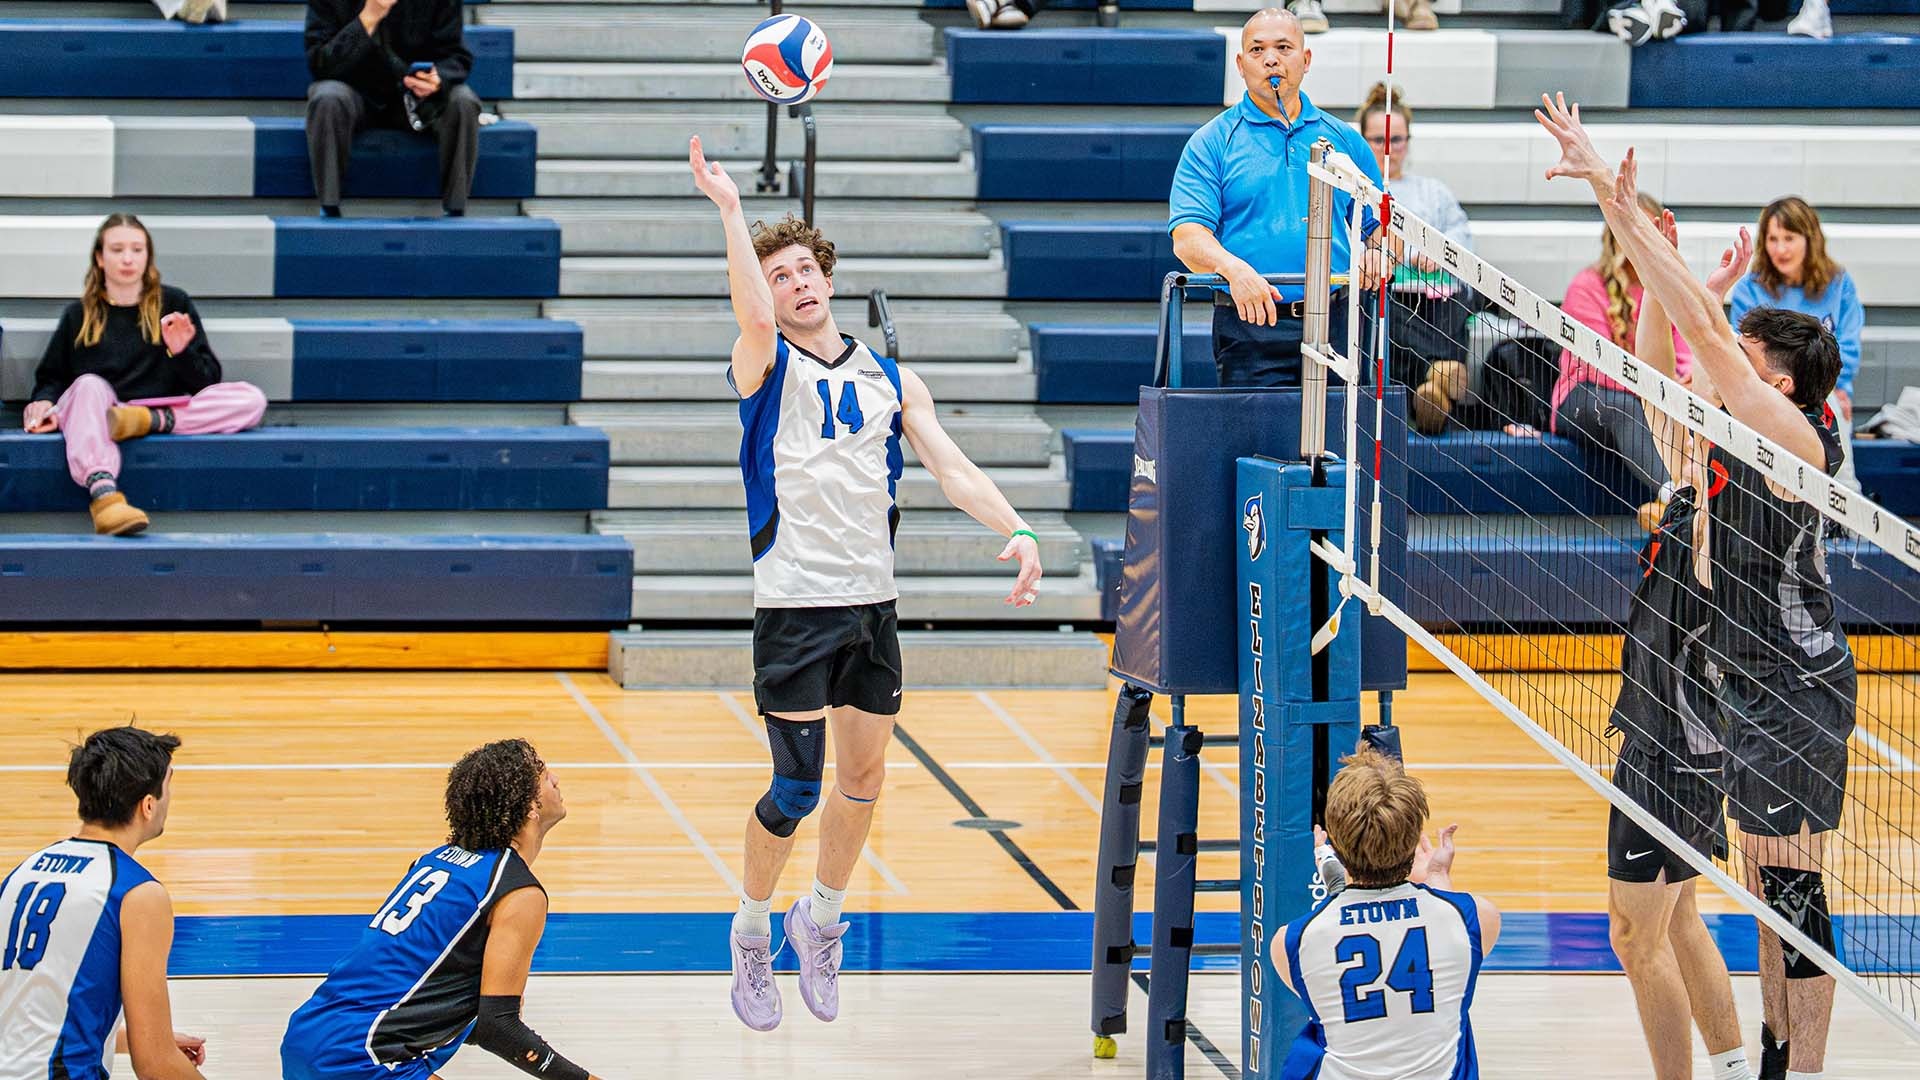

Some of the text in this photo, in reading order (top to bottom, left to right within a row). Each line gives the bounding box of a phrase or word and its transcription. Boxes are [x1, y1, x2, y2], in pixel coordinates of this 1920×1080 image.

[757, 69, 783, 95] NCAA
[816, 378, 865, 440] 14
[1248, 581, 1266, 1073] ELIZABETHTOWN
[31, 852, 95, 875] ETOWN
[2, 881, 67, 971] 18
[368, 865, 450, 937] 13
[1339, 898, 1420, 926] ETOWN
[1334, 925, 1436, 1024] 24
